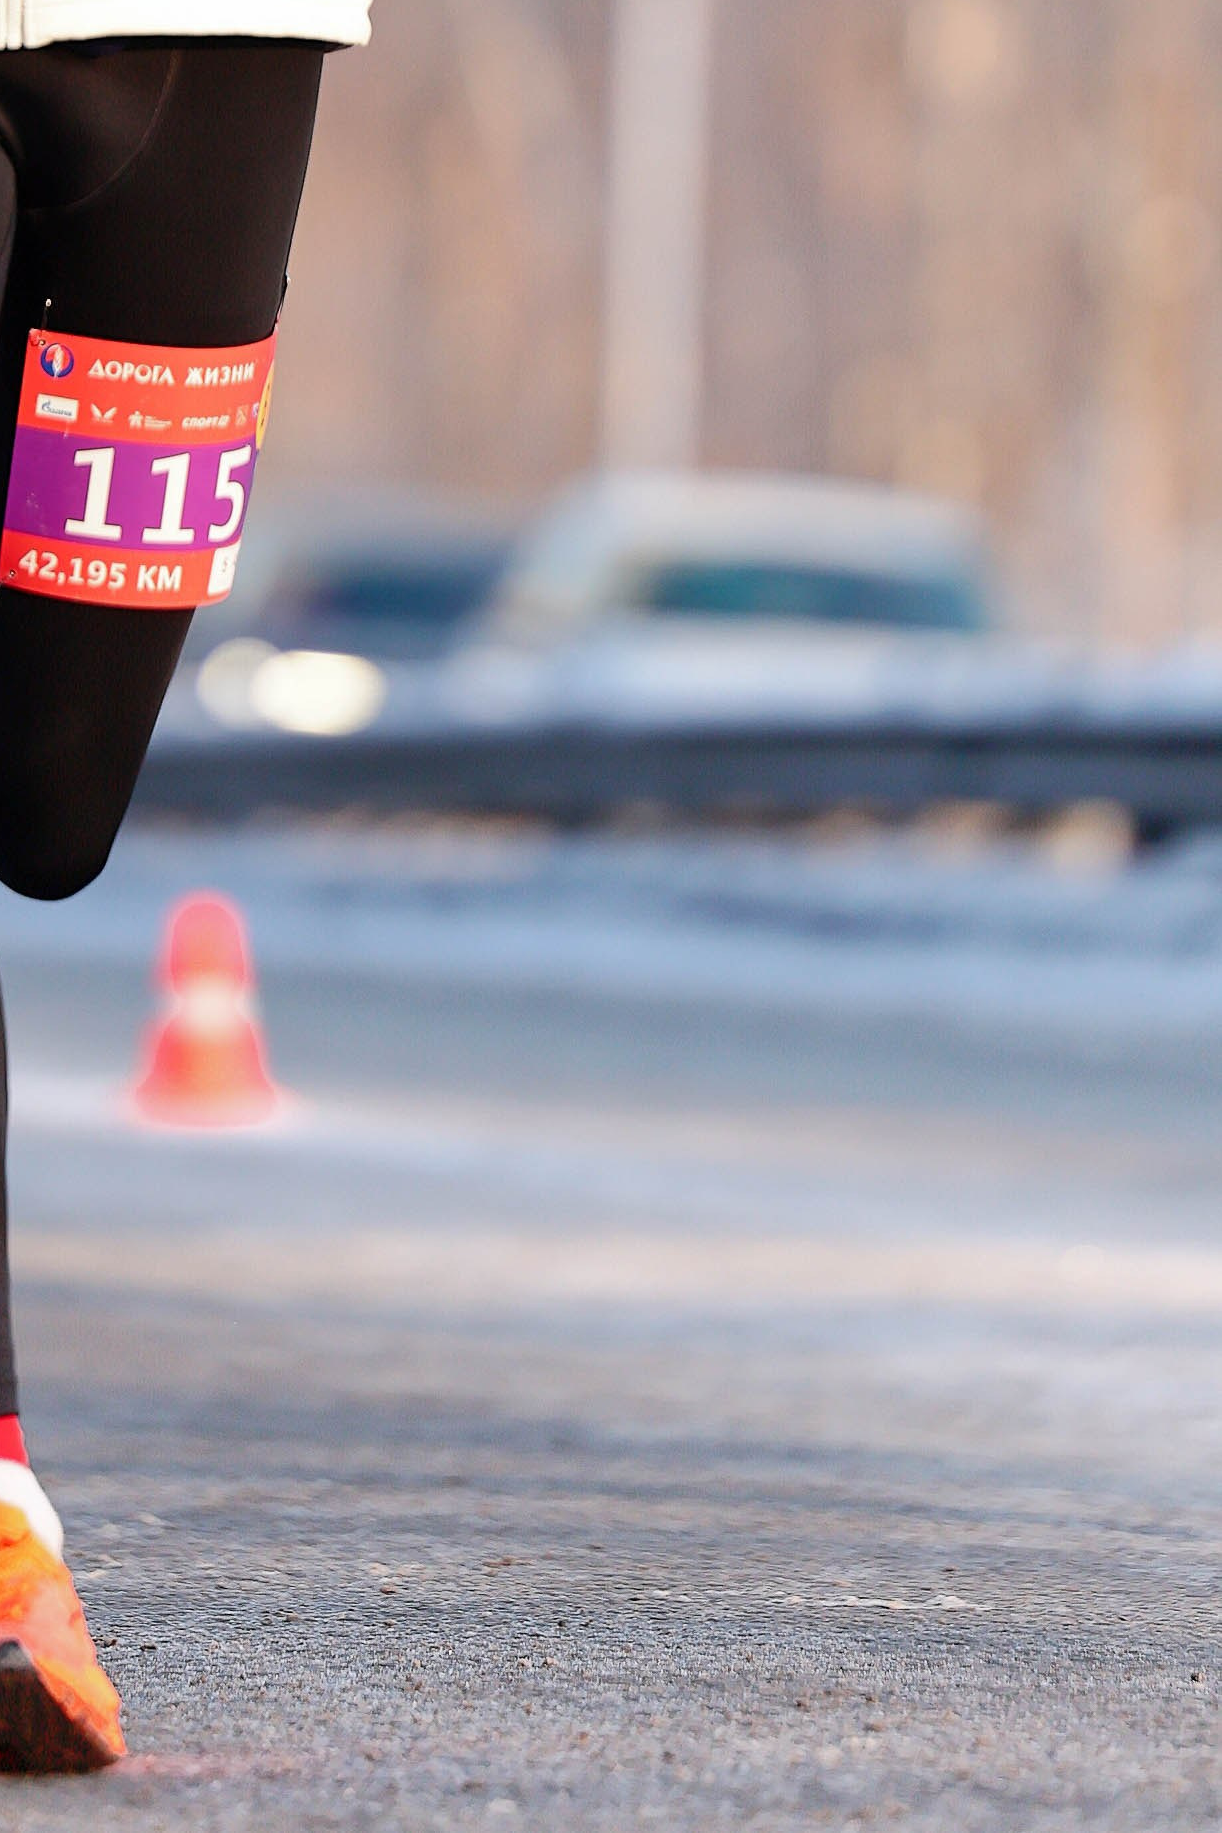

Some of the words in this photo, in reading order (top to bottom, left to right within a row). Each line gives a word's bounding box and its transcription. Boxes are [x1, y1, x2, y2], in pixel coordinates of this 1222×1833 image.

[88, 358, 175, 385] ДОРОГА
[185, 362, 255, 387] ЖИЗНИ
[64, 446, 252, 544] 115
[18, 549, 128, 589] 42,195
[137, 565, 183, 591] КМ
